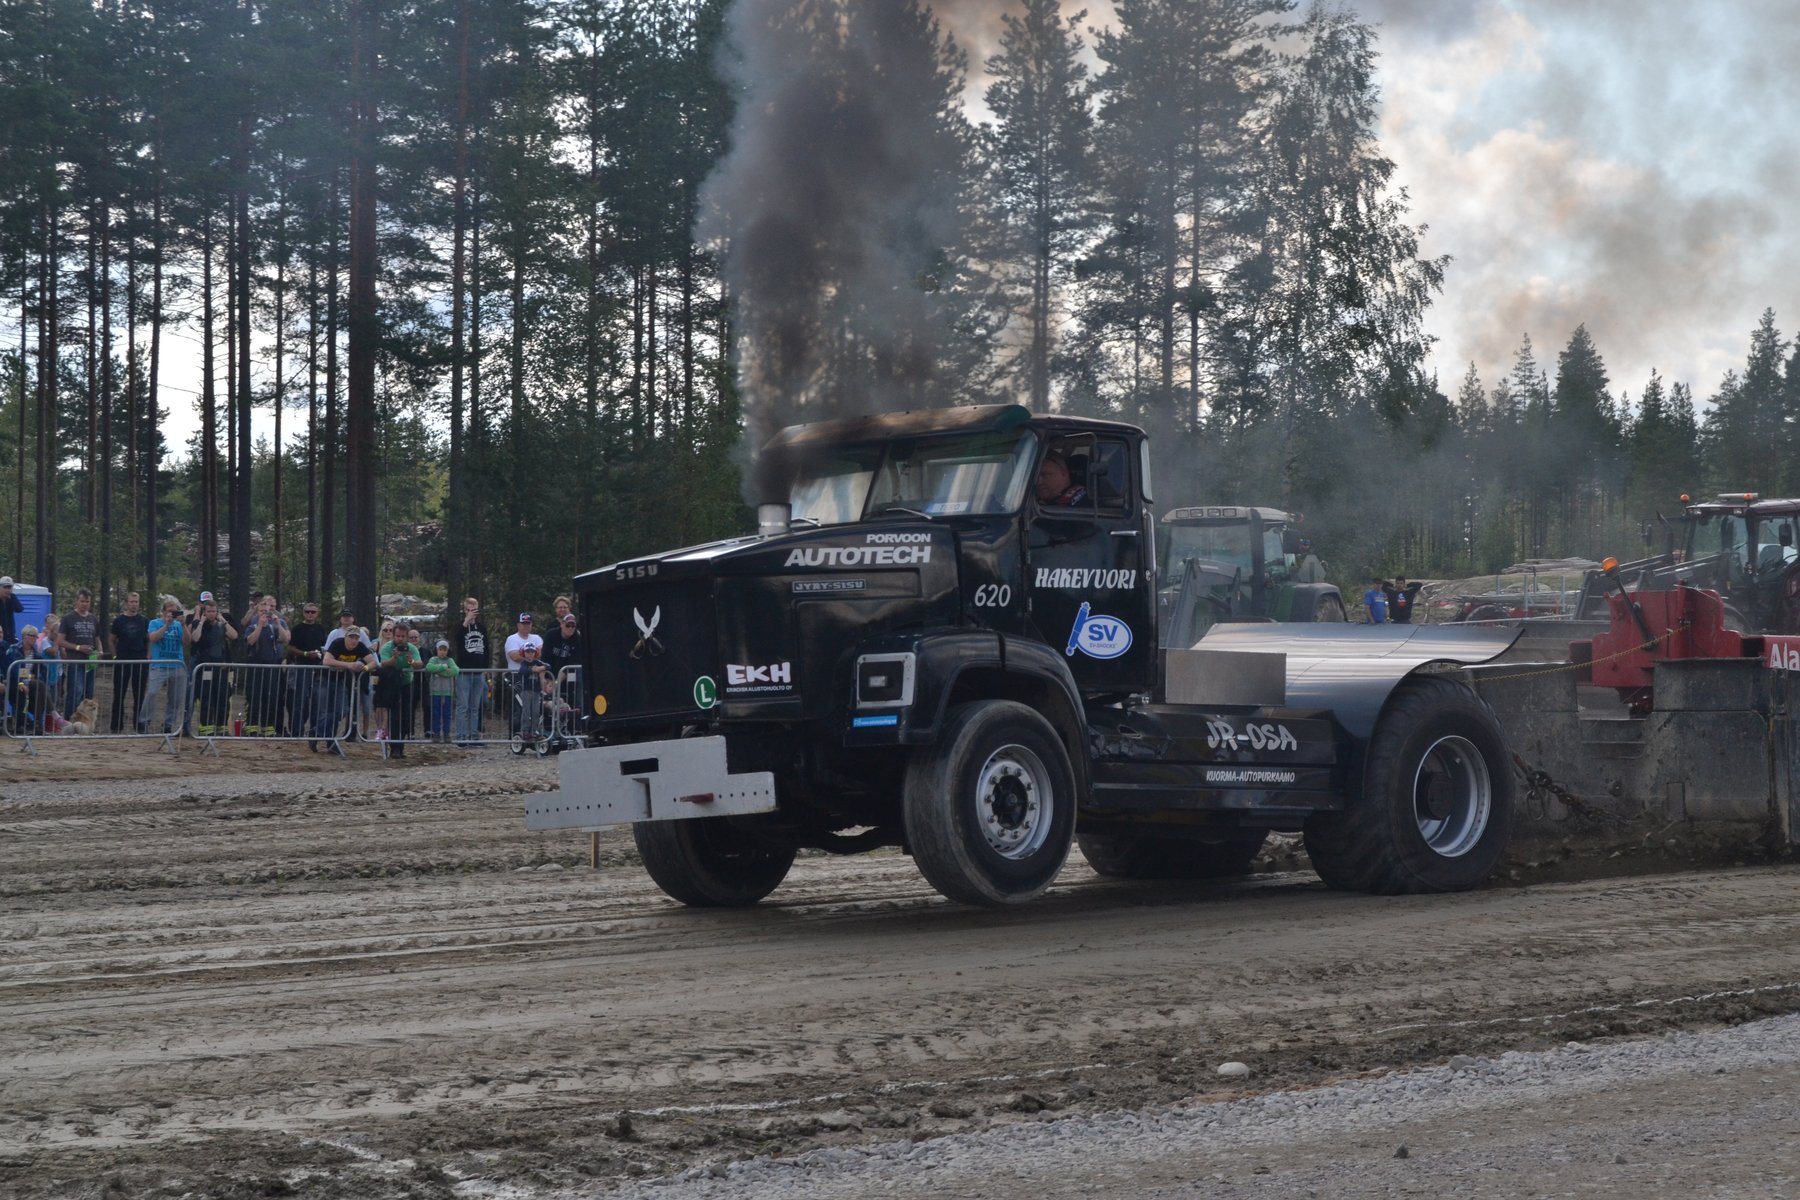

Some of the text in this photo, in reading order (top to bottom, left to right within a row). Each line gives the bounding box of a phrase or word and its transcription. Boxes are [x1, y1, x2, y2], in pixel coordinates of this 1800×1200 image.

[866, 533, 932, 544] PORVOON
[784, 546, 932, 567] AUTOTECH
[616, 564, 658, 580] SISU
[1035, 567, 1137, 589] HAKEVUORI
[795, 581, 864, 591] JYRY-SISU
[974, 584, 1012, 608] 620
[1088, 623, 1119, 642] SV
[726, 662, 792, 685] EKH
[700, 683, 712, 703] L
[1206, 721, 1298, 751] JR-OSA
[1206, 770, 1296, 783] KUORMA-AUTOPURKAAMO
